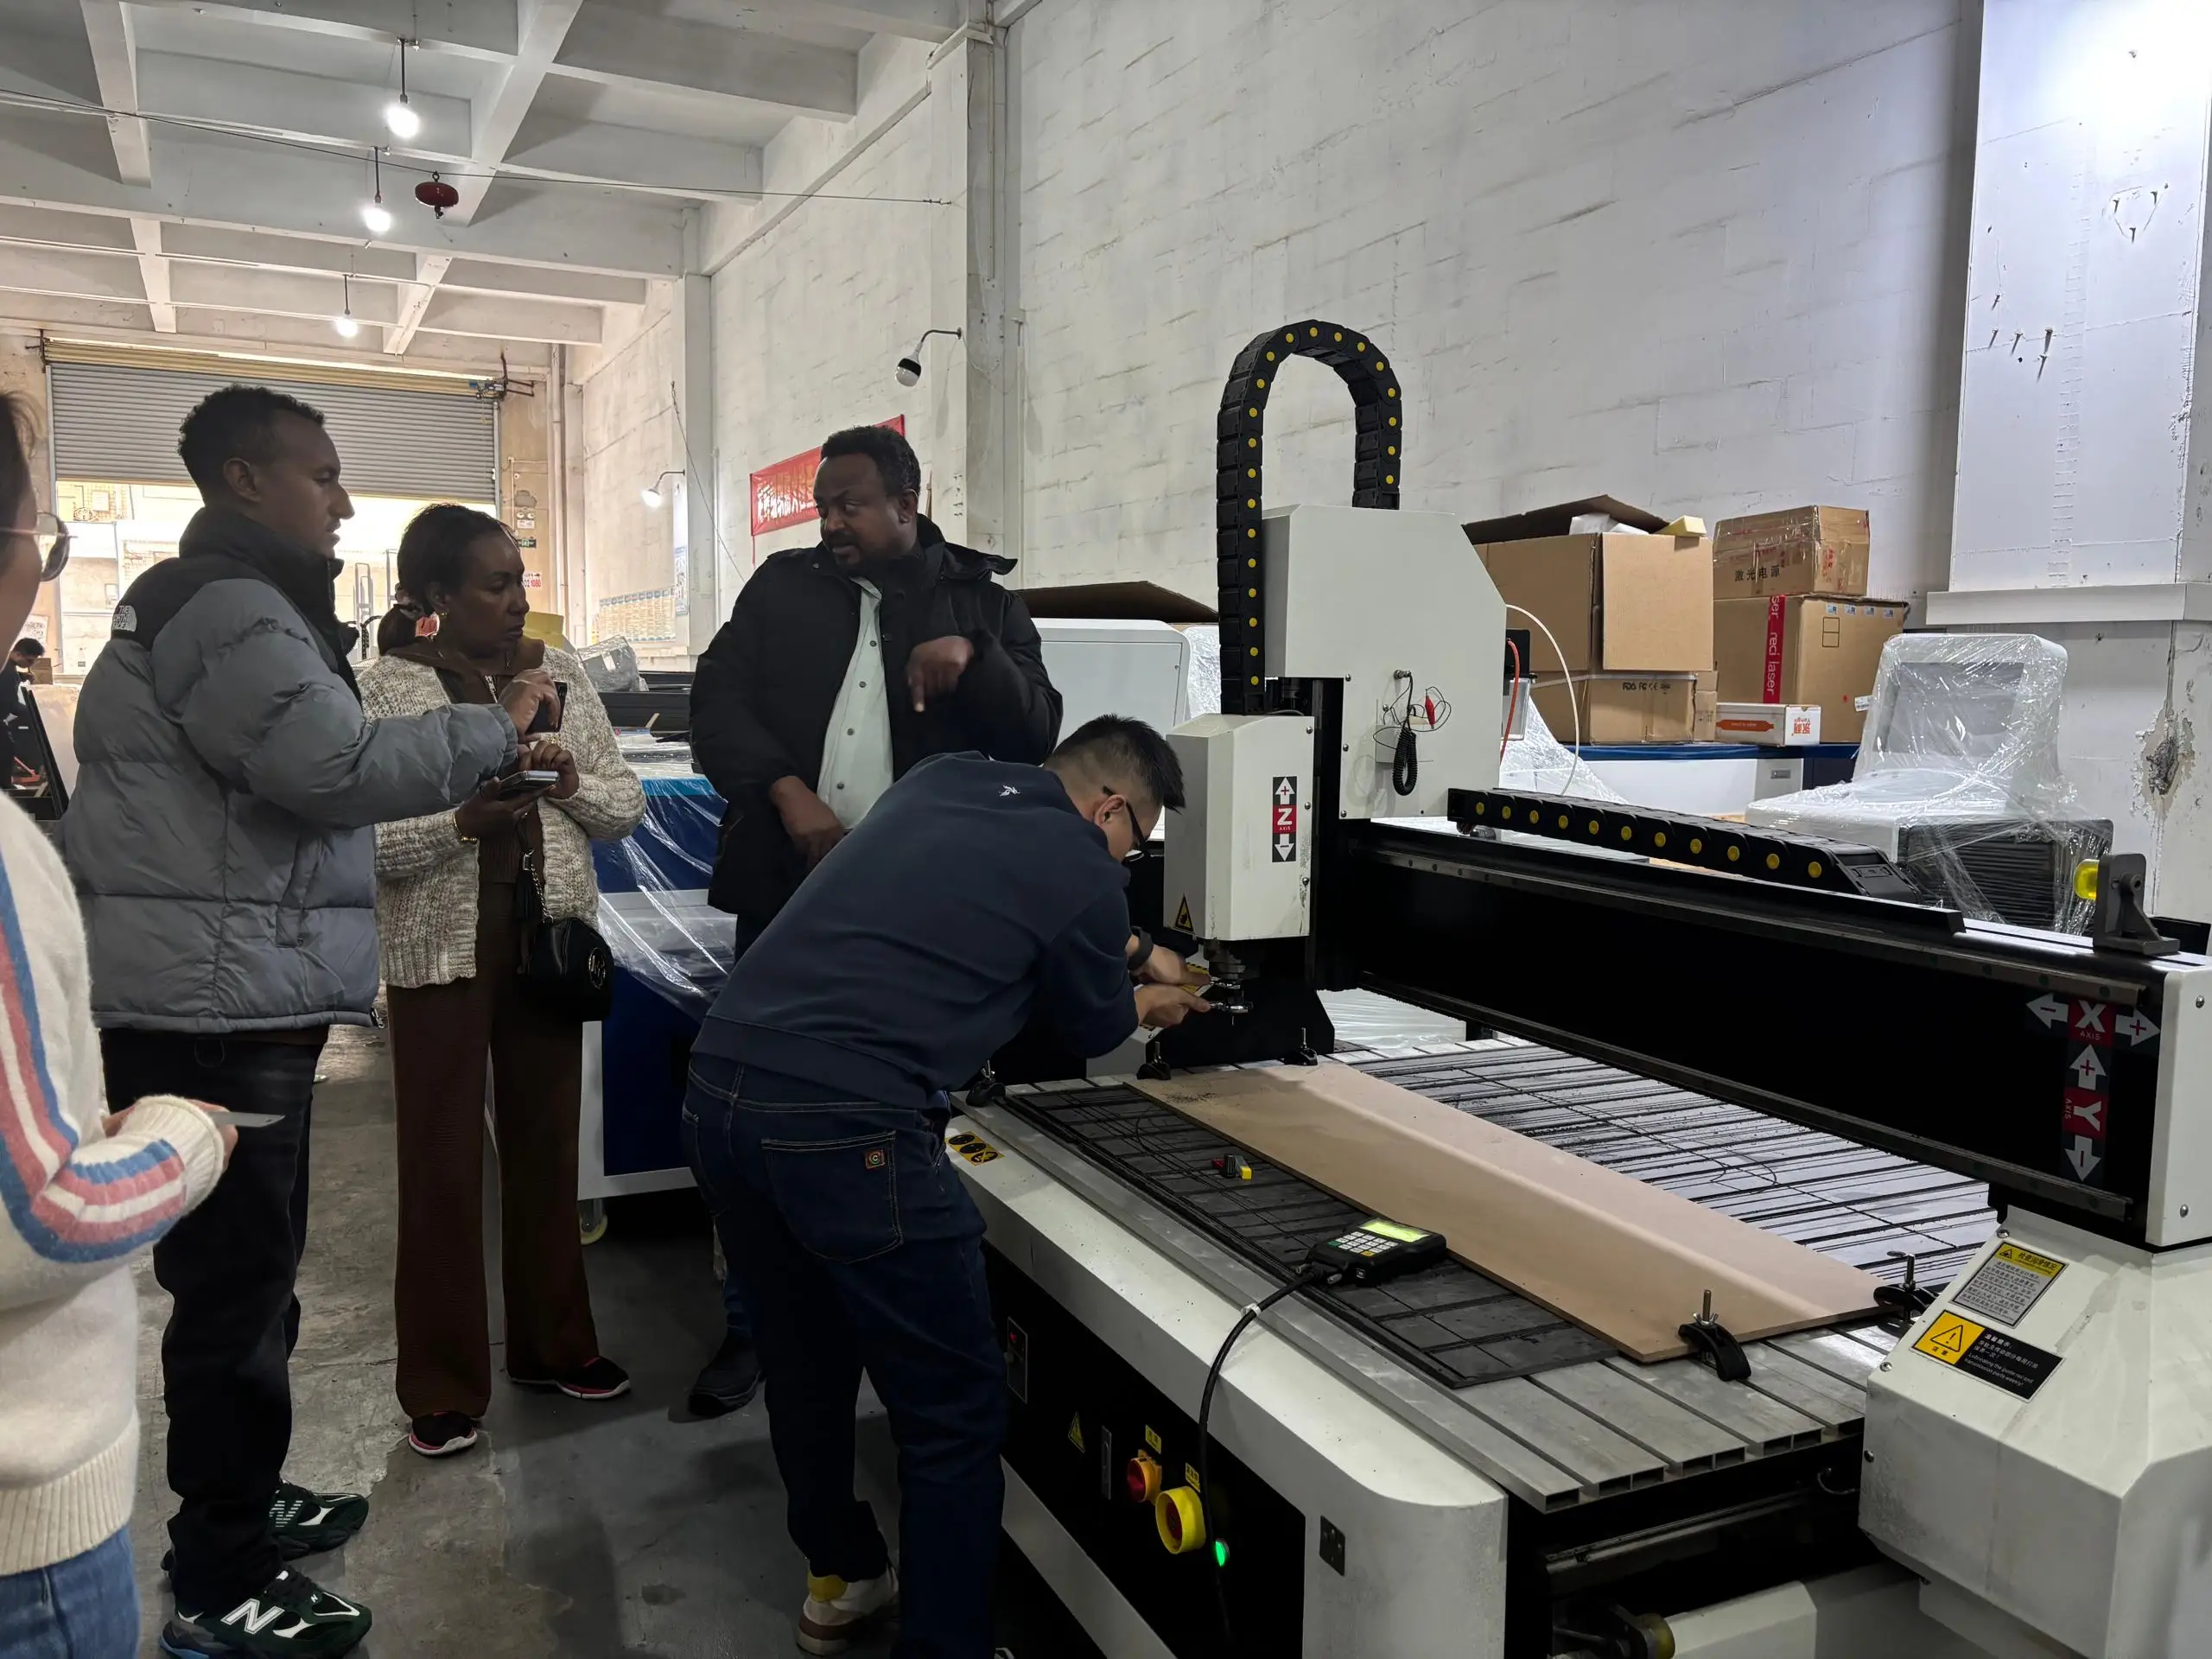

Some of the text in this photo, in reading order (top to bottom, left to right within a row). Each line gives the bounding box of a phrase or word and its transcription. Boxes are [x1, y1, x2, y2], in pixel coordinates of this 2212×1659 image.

[1735, 565, 1780, 582] 激光电源
[1770, 632, 1780, 656] reci
[1767, 661, 1780, 696] laser
[1277, 808, 1293, 826] Z
[2075, 1000, 2107, 1033] X
[2080, 1031, 2101, 1040] AXIS
[2074, 1101, 2101, 1132] Y
[220, 1598, 285, 1635] N
